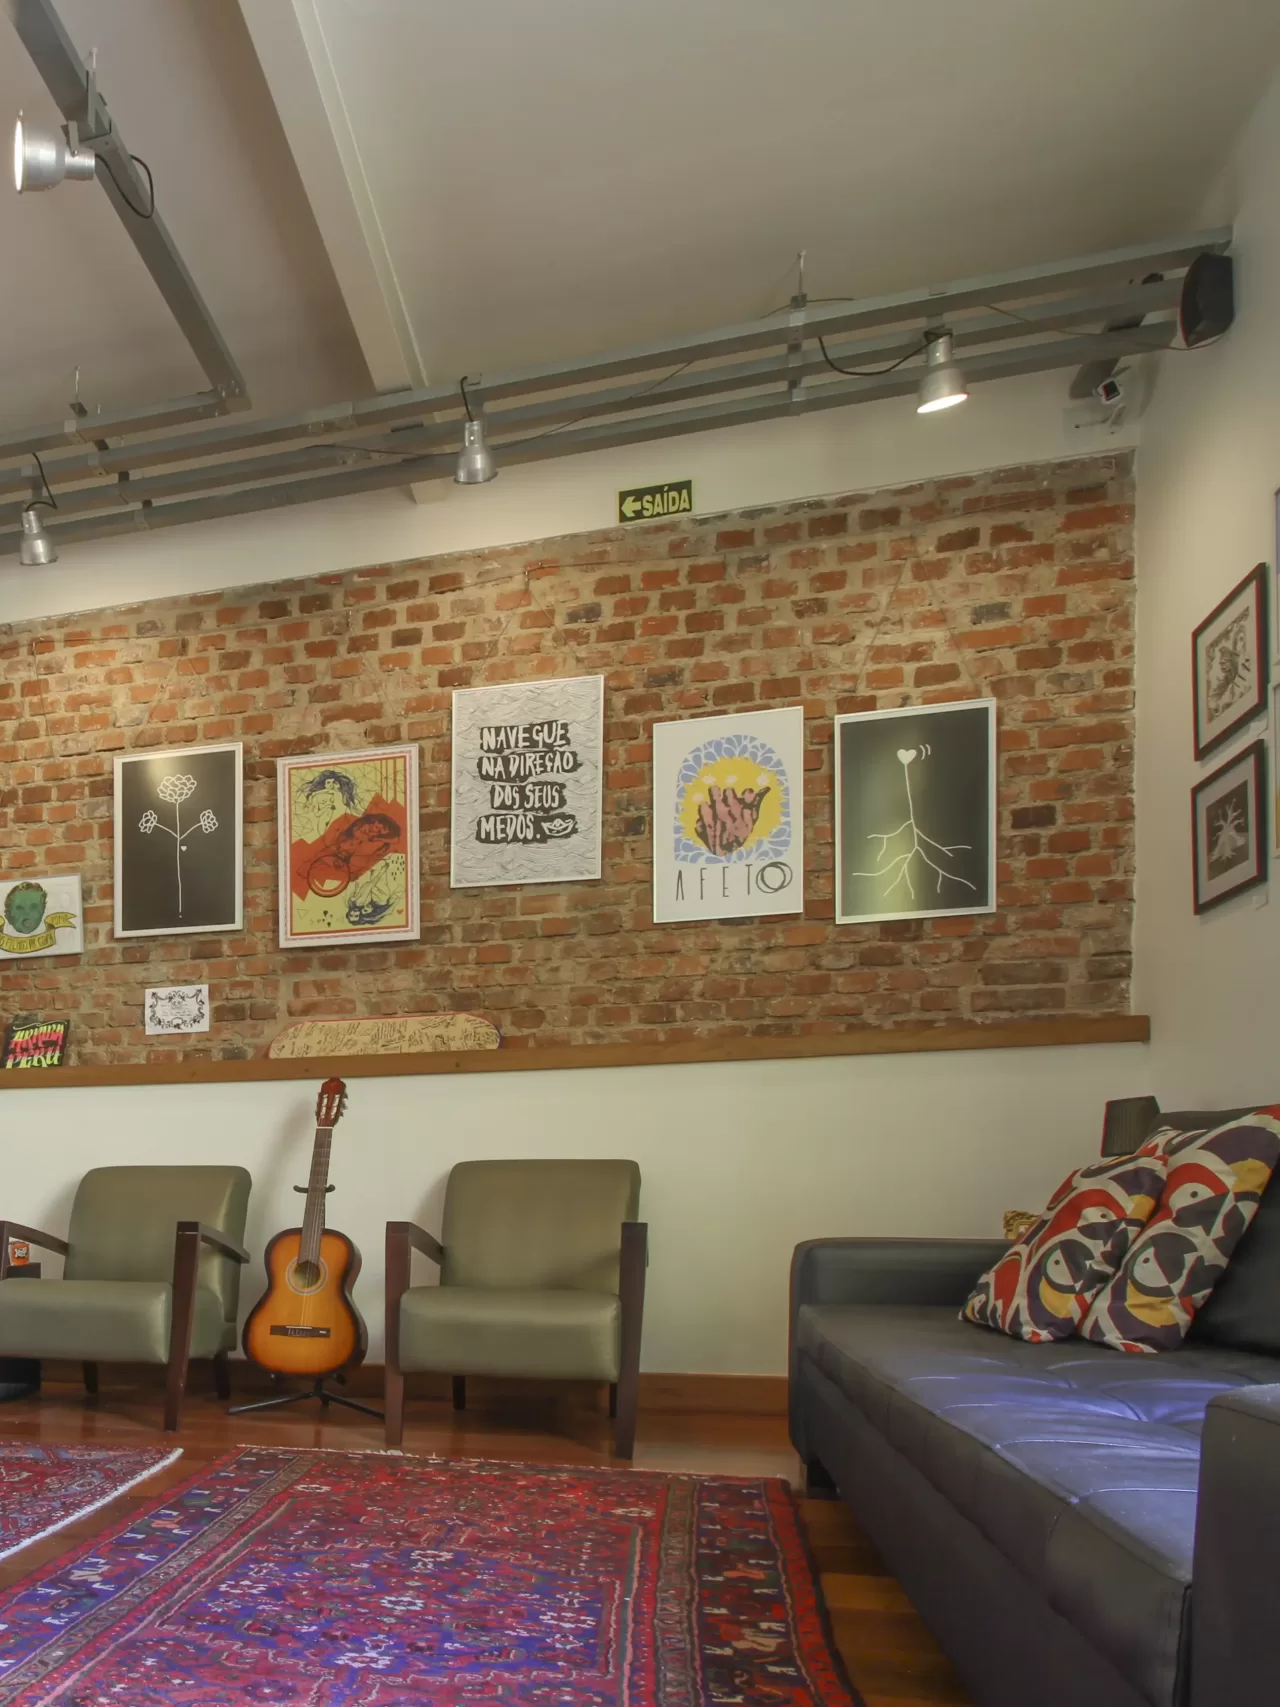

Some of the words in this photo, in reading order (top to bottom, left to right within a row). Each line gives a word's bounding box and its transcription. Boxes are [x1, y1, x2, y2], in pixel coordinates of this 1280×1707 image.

[642, 485, 690, 517] SAÍDA
[481, 756, 506, 779] NA
[508, 746, 574, 777] DIREÇÃO
[493, 785, 520, 809] DOS
[524, 783, 560, 808] SEUS
[675, 861, 794, 901] AFETO
